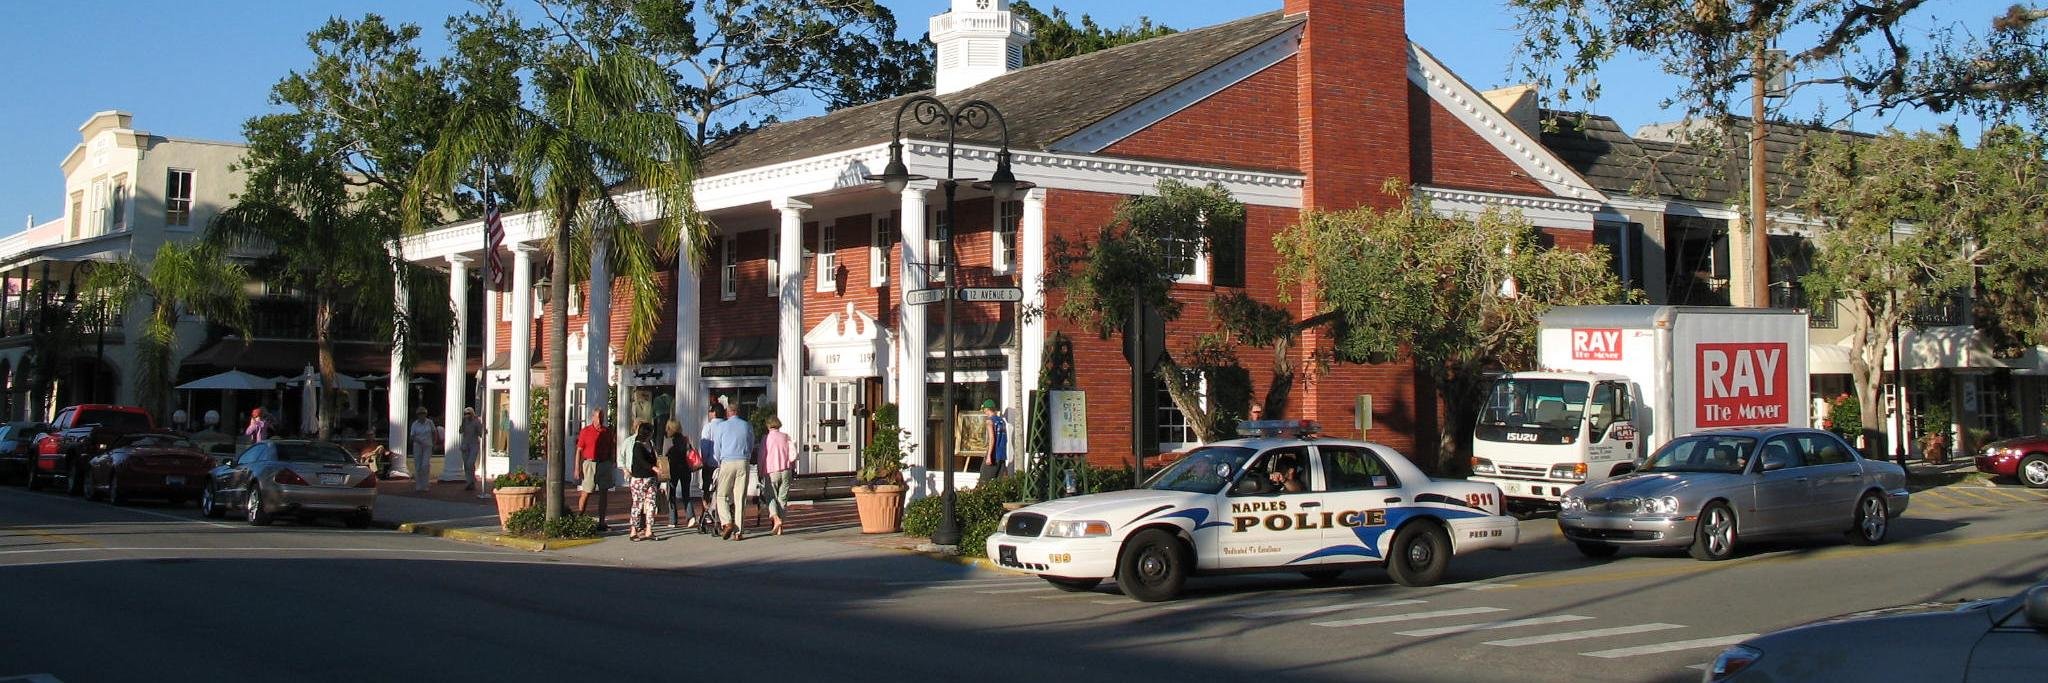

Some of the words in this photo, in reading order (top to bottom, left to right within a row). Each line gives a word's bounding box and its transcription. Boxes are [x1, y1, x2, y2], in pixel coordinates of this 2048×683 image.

[969, 290, 977, 300] 12
[981, 290, 1004, 300] AVENUE
[1008, 290, 1013, 300] S
[1574, 331, 1619, 352] RAY
[1703, 348, 1781, 399] RAY
[1703, 404, 1732, 421] The
[1737, 403, 1782, 420] Mover
[1507, 432, 1538, 441] ISUZU
[1232, 500, 1287, 513] NAPLES
[1470, 492, 1494, 507] 911
[1232, 508, 1387, 533] POLICE
